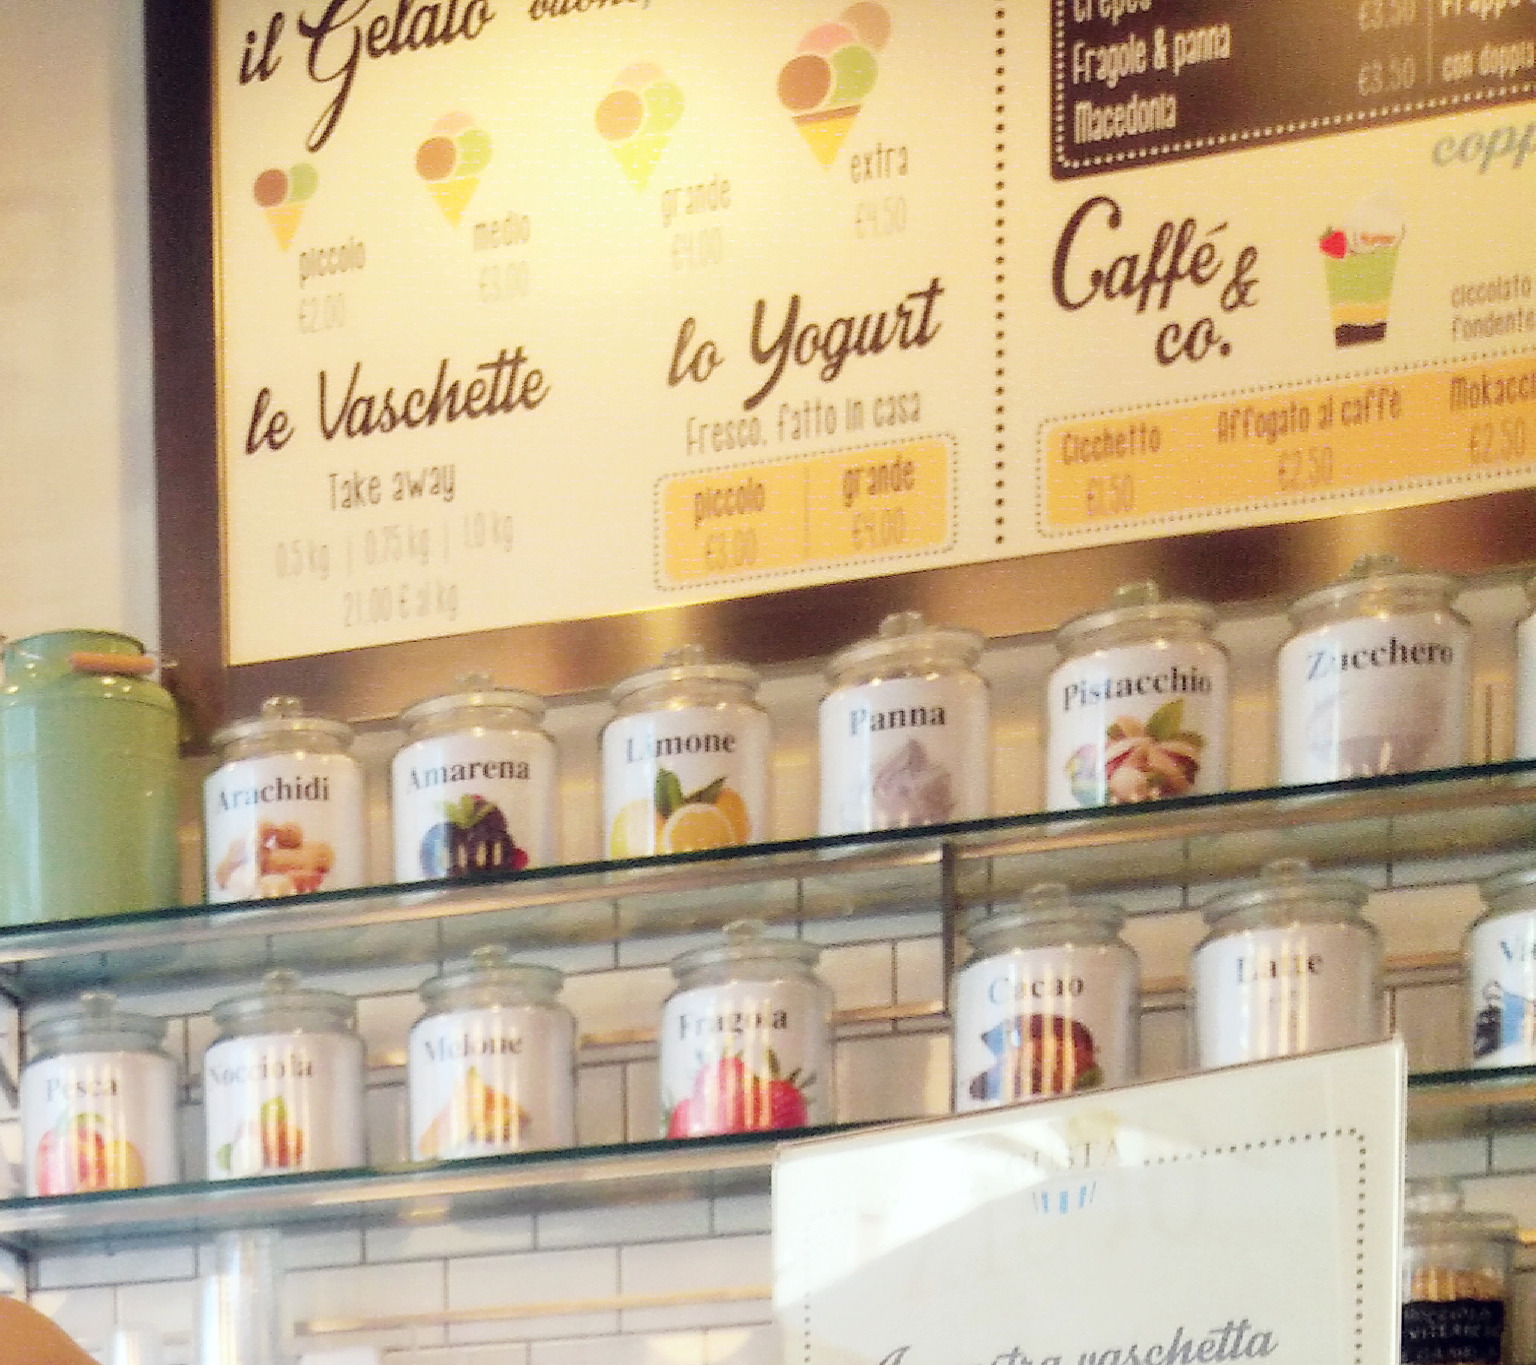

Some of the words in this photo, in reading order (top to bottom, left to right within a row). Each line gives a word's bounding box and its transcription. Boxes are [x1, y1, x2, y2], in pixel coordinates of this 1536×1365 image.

[239, 12, 285, 86] il
[297, 0, 496, 153] Gelato
[1072, 31, 1147, 89] Fragole
[1153, 26, 1167, 70] &
[1173, 22, 1231, 77] panna
[1073, 92, 1177, 145] Macedonia
[850, 142, 909, 184] extra
[1221, 244, 1259, 312] &
[667, 317, 725, 387] lo
[743, 276, 945, 412] Yogurt
[1155, 316, 1232, 366] co.
[245, 387, 294, 455] le
[317, 346, 552, 440] Vaschette
[845, 397, 862, 431] in
[872, 391, 921, 428] casa
[329, 469, 382, 510] Take
[392, 463, 457, 502] away
[694, 476, 765, 529] piccolo
[842, 453, 915, 508] grande
[1307, 637, 1455, 681] Zucchero
[1063, 666, 1214, 712] Pistacchio
[848, 703, 947, 737] Panna
[217, 775, 331, 812] Arachidi
[407, 758, 531, 795] Amarena
